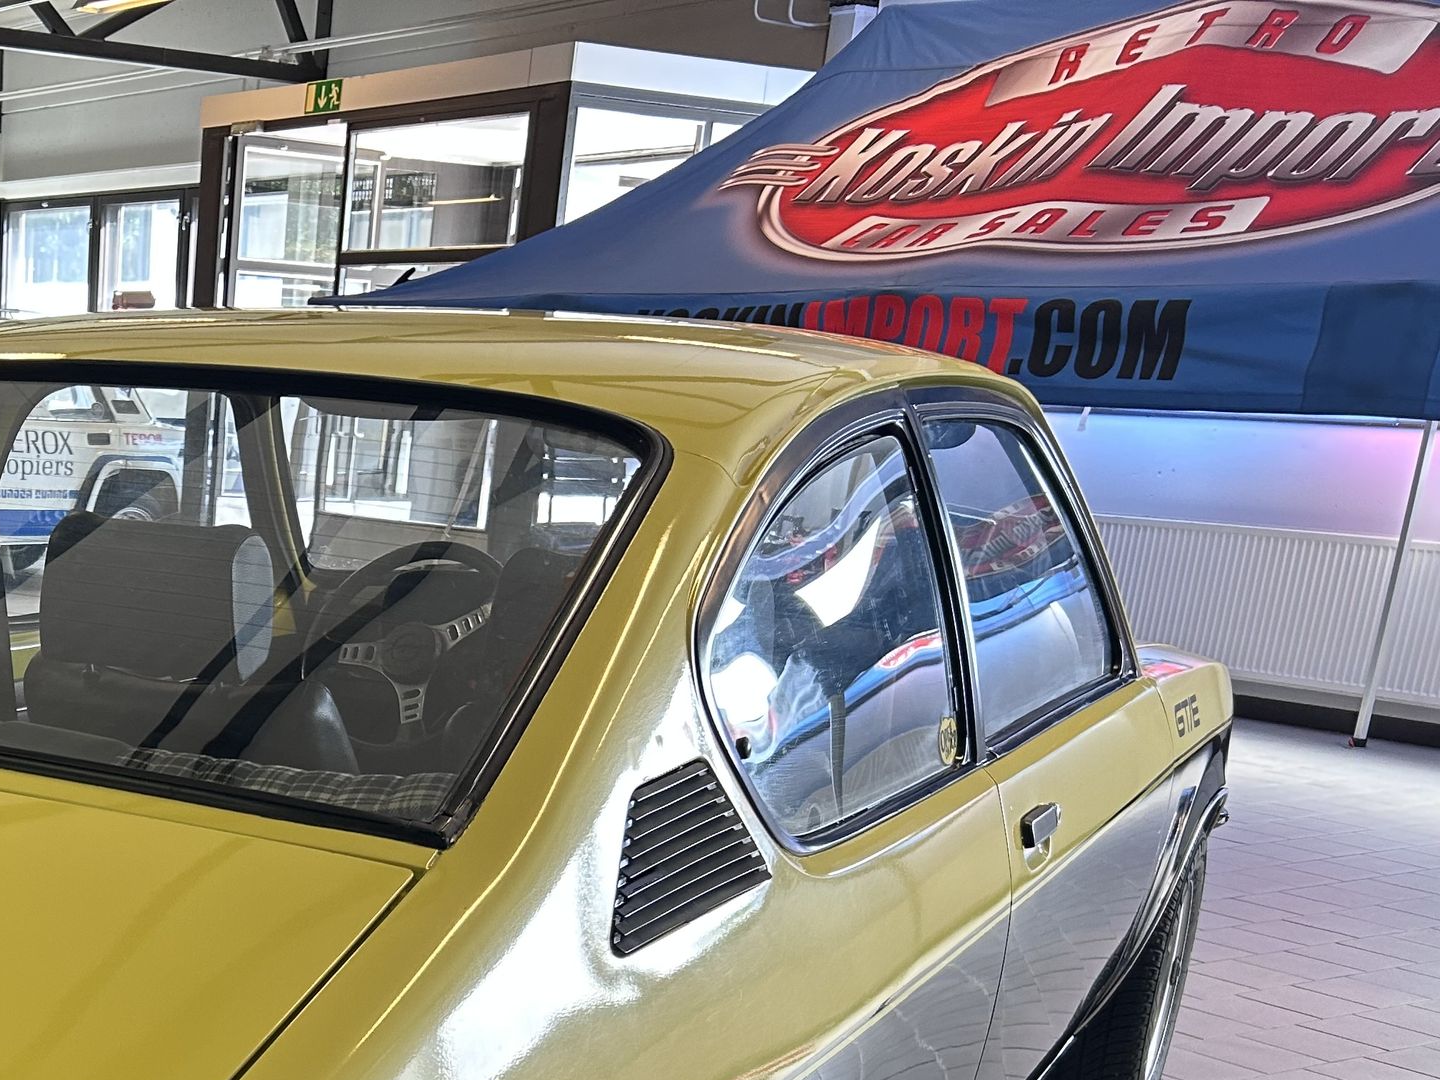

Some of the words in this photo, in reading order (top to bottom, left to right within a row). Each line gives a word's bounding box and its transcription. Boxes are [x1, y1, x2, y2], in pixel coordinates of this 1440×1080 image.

[1047, 7, 1372, 87] RETRO
[790, 107, 1113, 206] Koskin
[841, 222, 959, 249] CAR
[967, 204, 1235, 239] SALES
[638, 296, 1192, 381] PORT.COM
[3, 455, 74, 481] opiers
[12, 430, 74, 456] EROX
